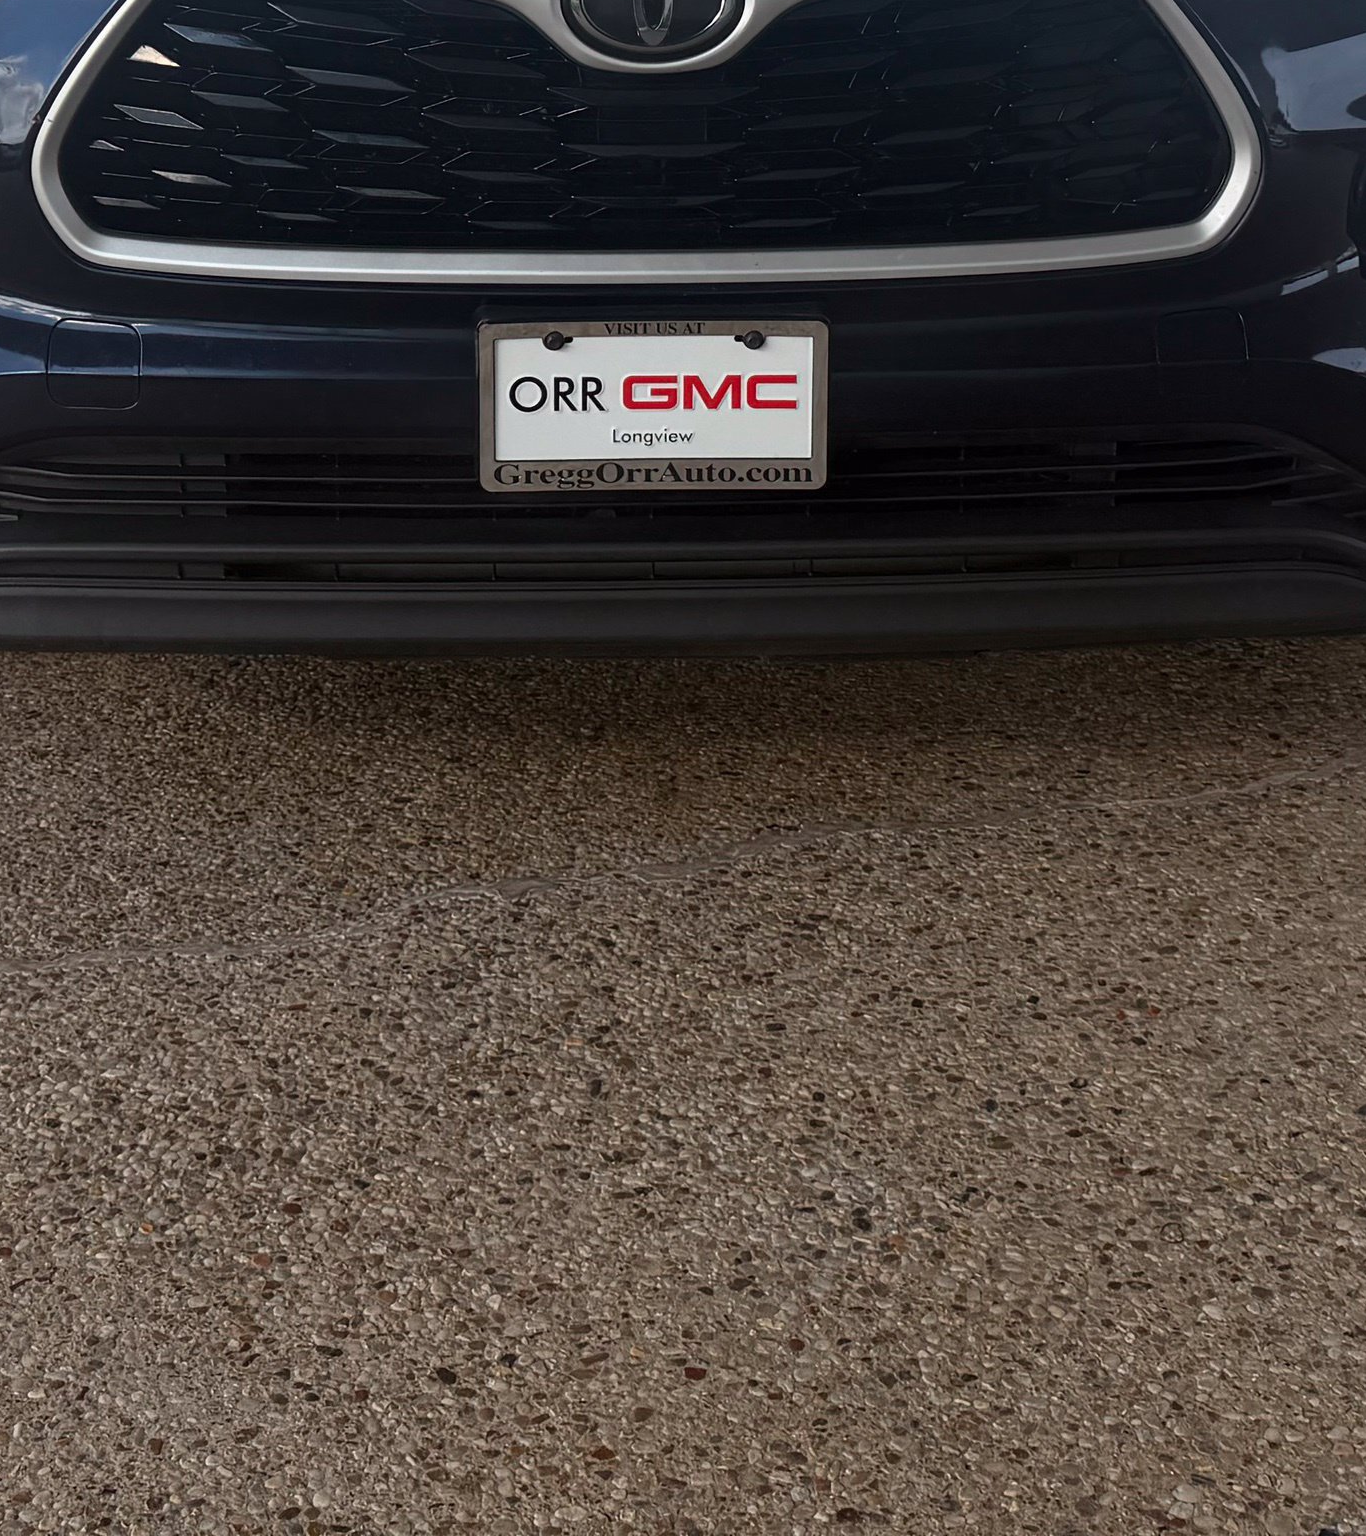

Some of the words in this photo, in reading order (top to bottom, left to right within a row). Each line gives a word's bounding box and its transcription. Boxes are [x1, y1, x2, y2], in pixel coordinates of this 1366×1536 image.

[603, 322, 652, 335] VISIT
[655, 322, 679, 335] US
[681, 322, 706, 335] AT
[509, 376, 607, 413] ORR
[623, 374, 798, 411] GMC
[612, 429, 693, 447] Longview
[494, 461, 814, 490] GreggOrrAuto.com
